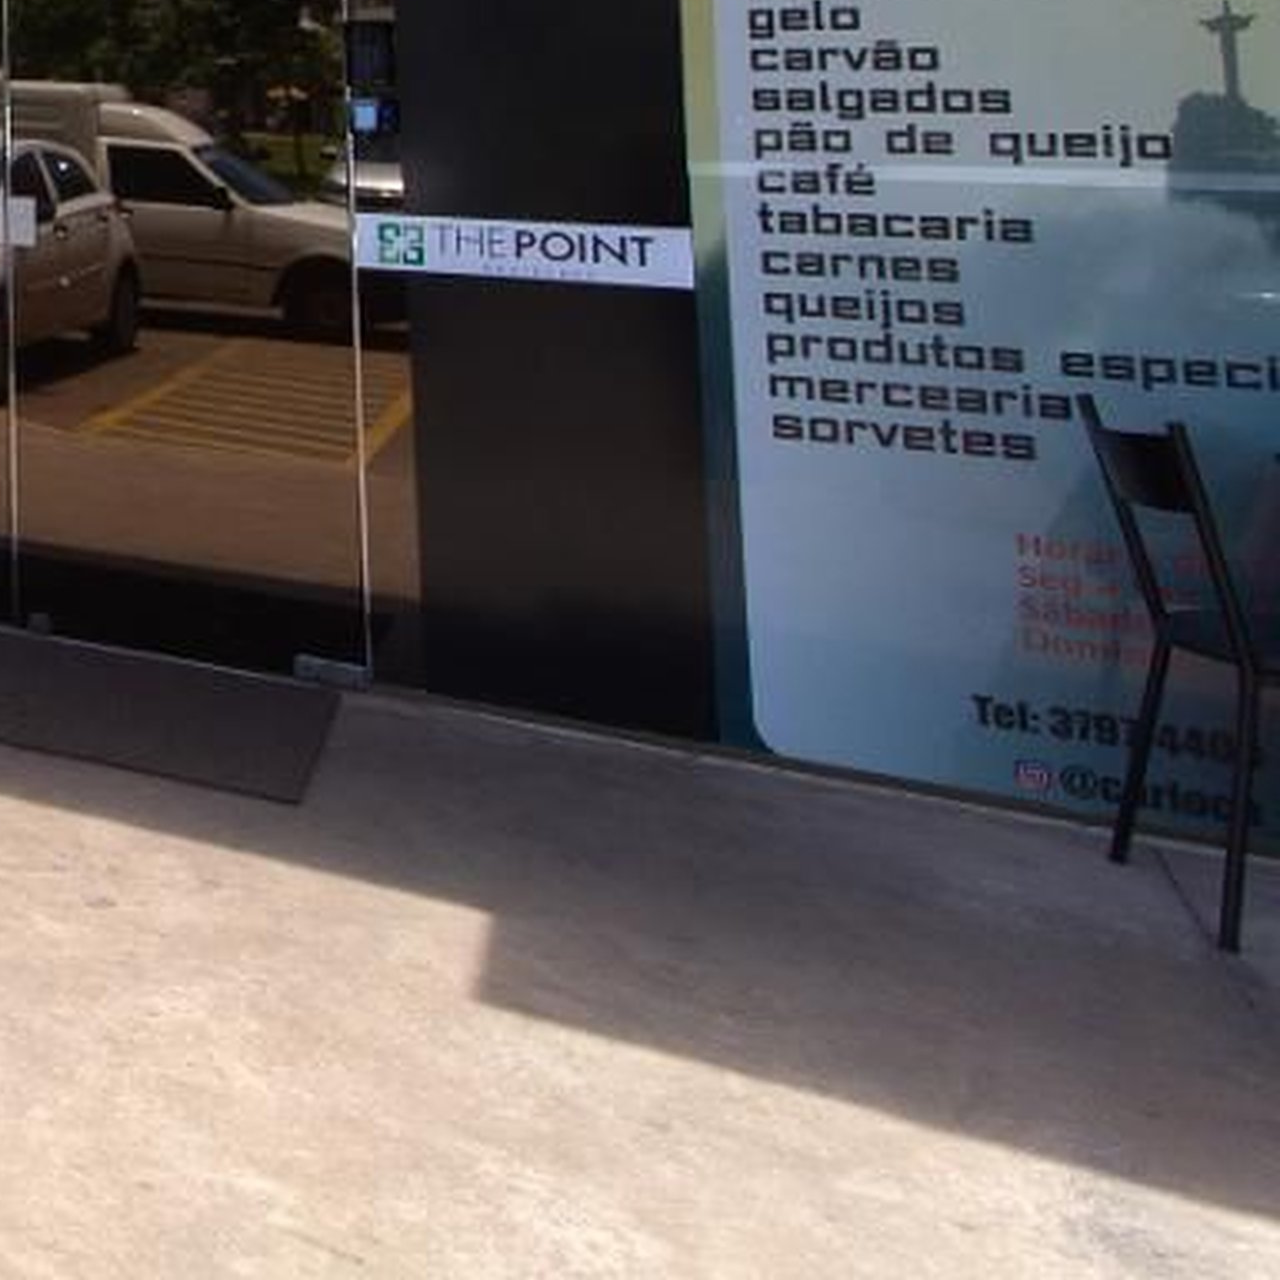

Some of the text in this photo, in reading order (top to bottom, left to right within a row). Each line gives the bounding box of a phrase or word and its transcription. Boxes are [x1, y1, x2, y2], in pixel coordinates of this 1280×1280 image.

[747, 1, 862, 39] gelo
[748, 39, 940, 72] carvão
[751, 81, 1013, 120] salgados
[754, 121, 1174, 167] pão de queijo
[756, 163, 876, 196] café
[756, 202, 1035, 245] tabacaria
[760, 248, 961, 284] carnes
[762, 289, 966, 331] queijos
[766, 329, 1025, 375] produtos
[768, 373, 1074, 421] mercearia
[771, 413, 1039, 461] sorvetes
[971, 693, 1040, 735] Tel:
